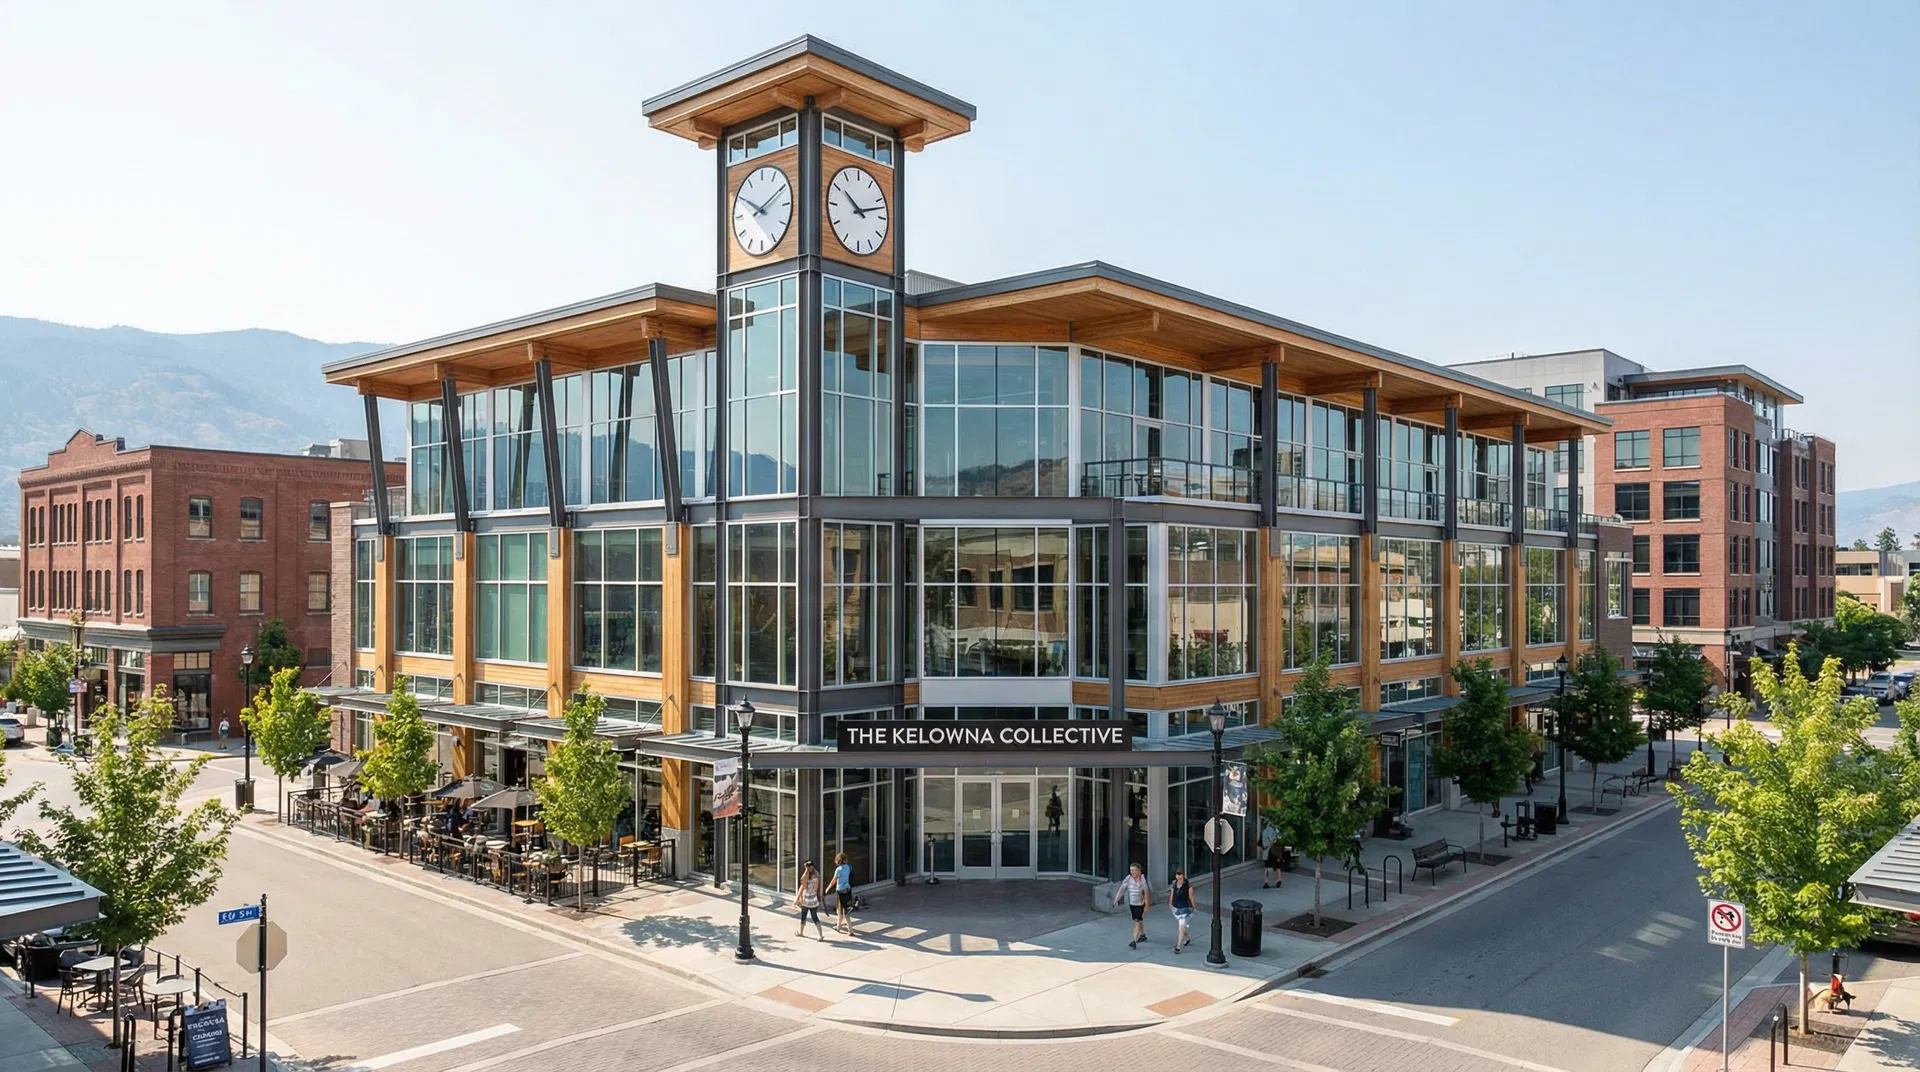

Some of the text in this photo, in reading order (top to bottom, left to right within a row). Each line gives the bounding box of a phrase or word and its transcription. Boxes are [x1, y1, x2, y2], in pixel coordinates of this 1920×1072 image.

[846, 727, 1123, 745] THE KELOWNA COLLECTIVE
